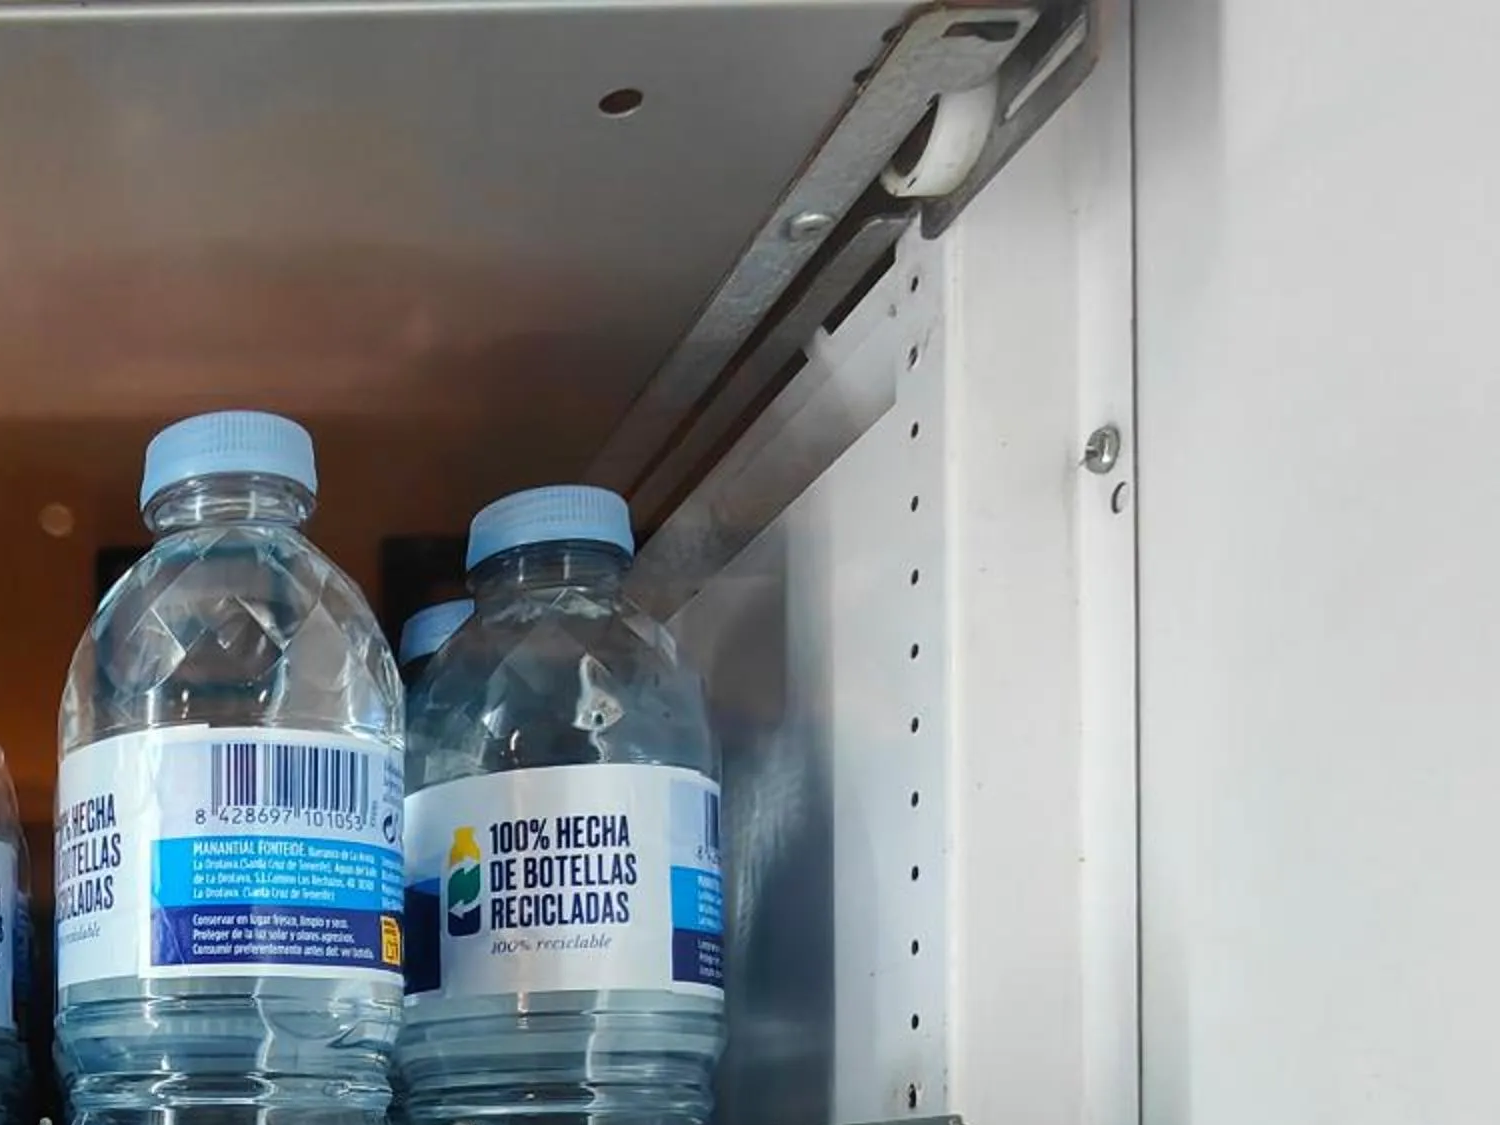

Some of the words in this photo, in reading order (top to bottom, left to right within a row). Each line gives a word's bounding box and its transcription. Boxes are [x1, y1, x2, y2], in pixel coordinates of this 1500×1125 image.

[72, 793, 116, 838] HECHA
[195, 810, 207, 824] 8
[219, 807, 293, 824] 428697
[490, 819, 550, 854] 100%
[556, 814, 630, 850] HECHA
[61, 833, 121, 880] TELLAS
[193, 840, 254, 856] MANANTIAL
[491, 859, 518, 893] DE
[524, 853, 637, 888] BOTELLAS
[491, 891, 630, 930] RECICLADAS
[193, 928, 229, 941] Proteger
[232, 929, 242, 940] de
[491, 940, 531, 955] 100%
[536, 933, 613, 953] reciclable
